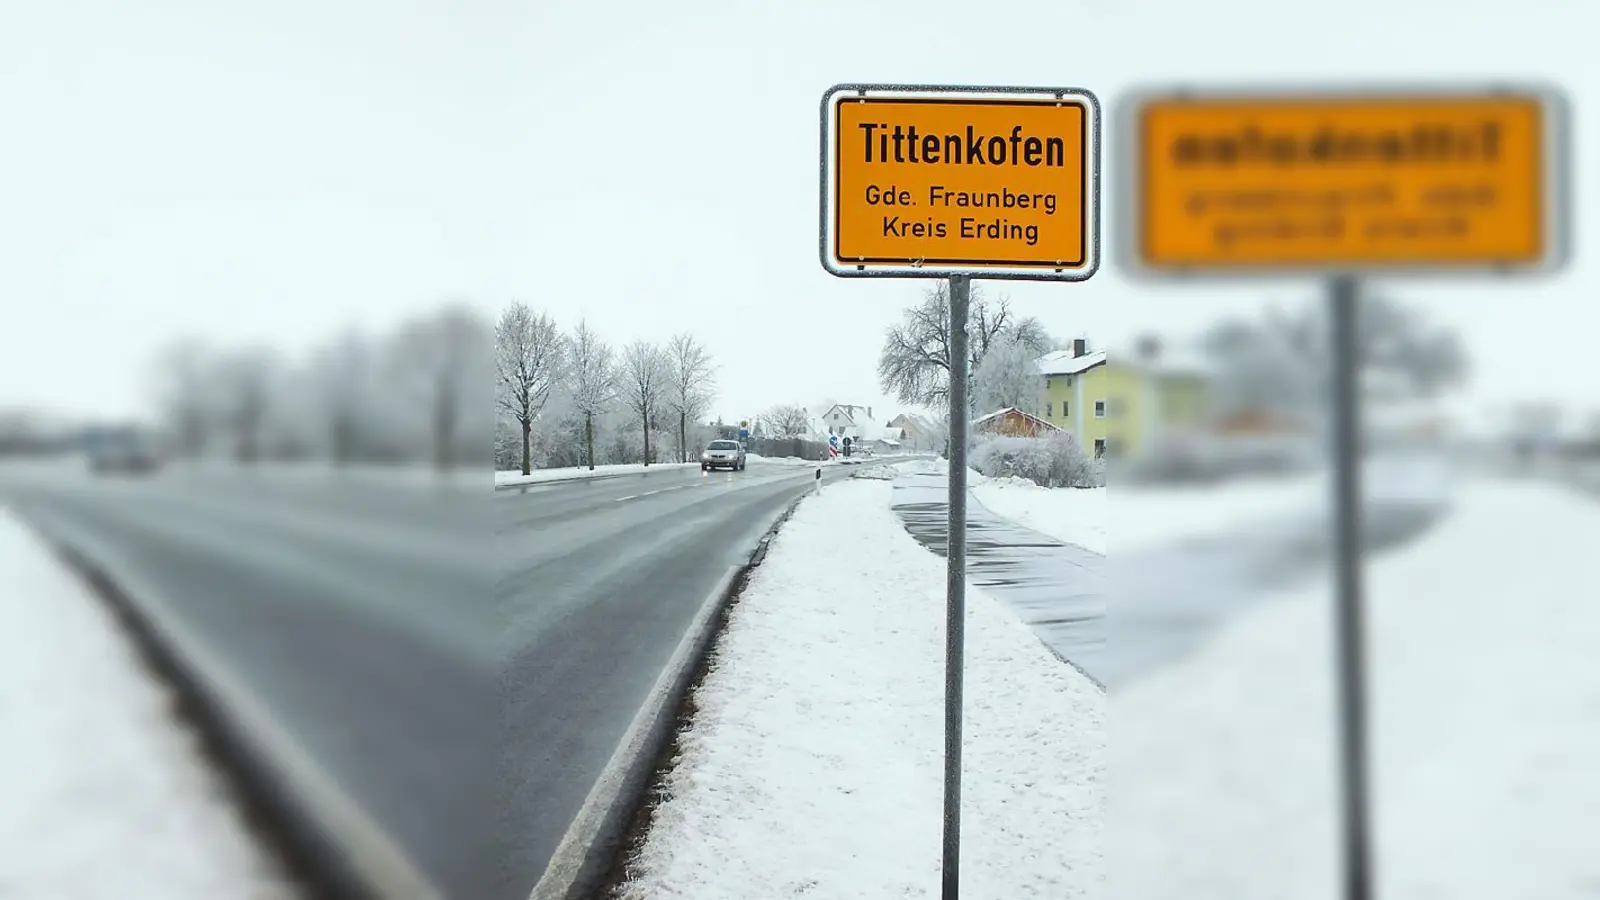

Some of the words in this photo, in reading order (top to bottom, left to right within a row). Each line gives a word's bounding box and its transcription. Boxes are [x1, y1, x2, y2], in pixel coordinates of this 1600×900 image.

[858, 123, 1064, 167] Tittenkofen
[865, 185, 917, 206] Gde.
[929, 186, 1056, 215] Fraunberg
[883, 216, 947, 238] Kreis
[960, 217, 1038, 246] Erding
